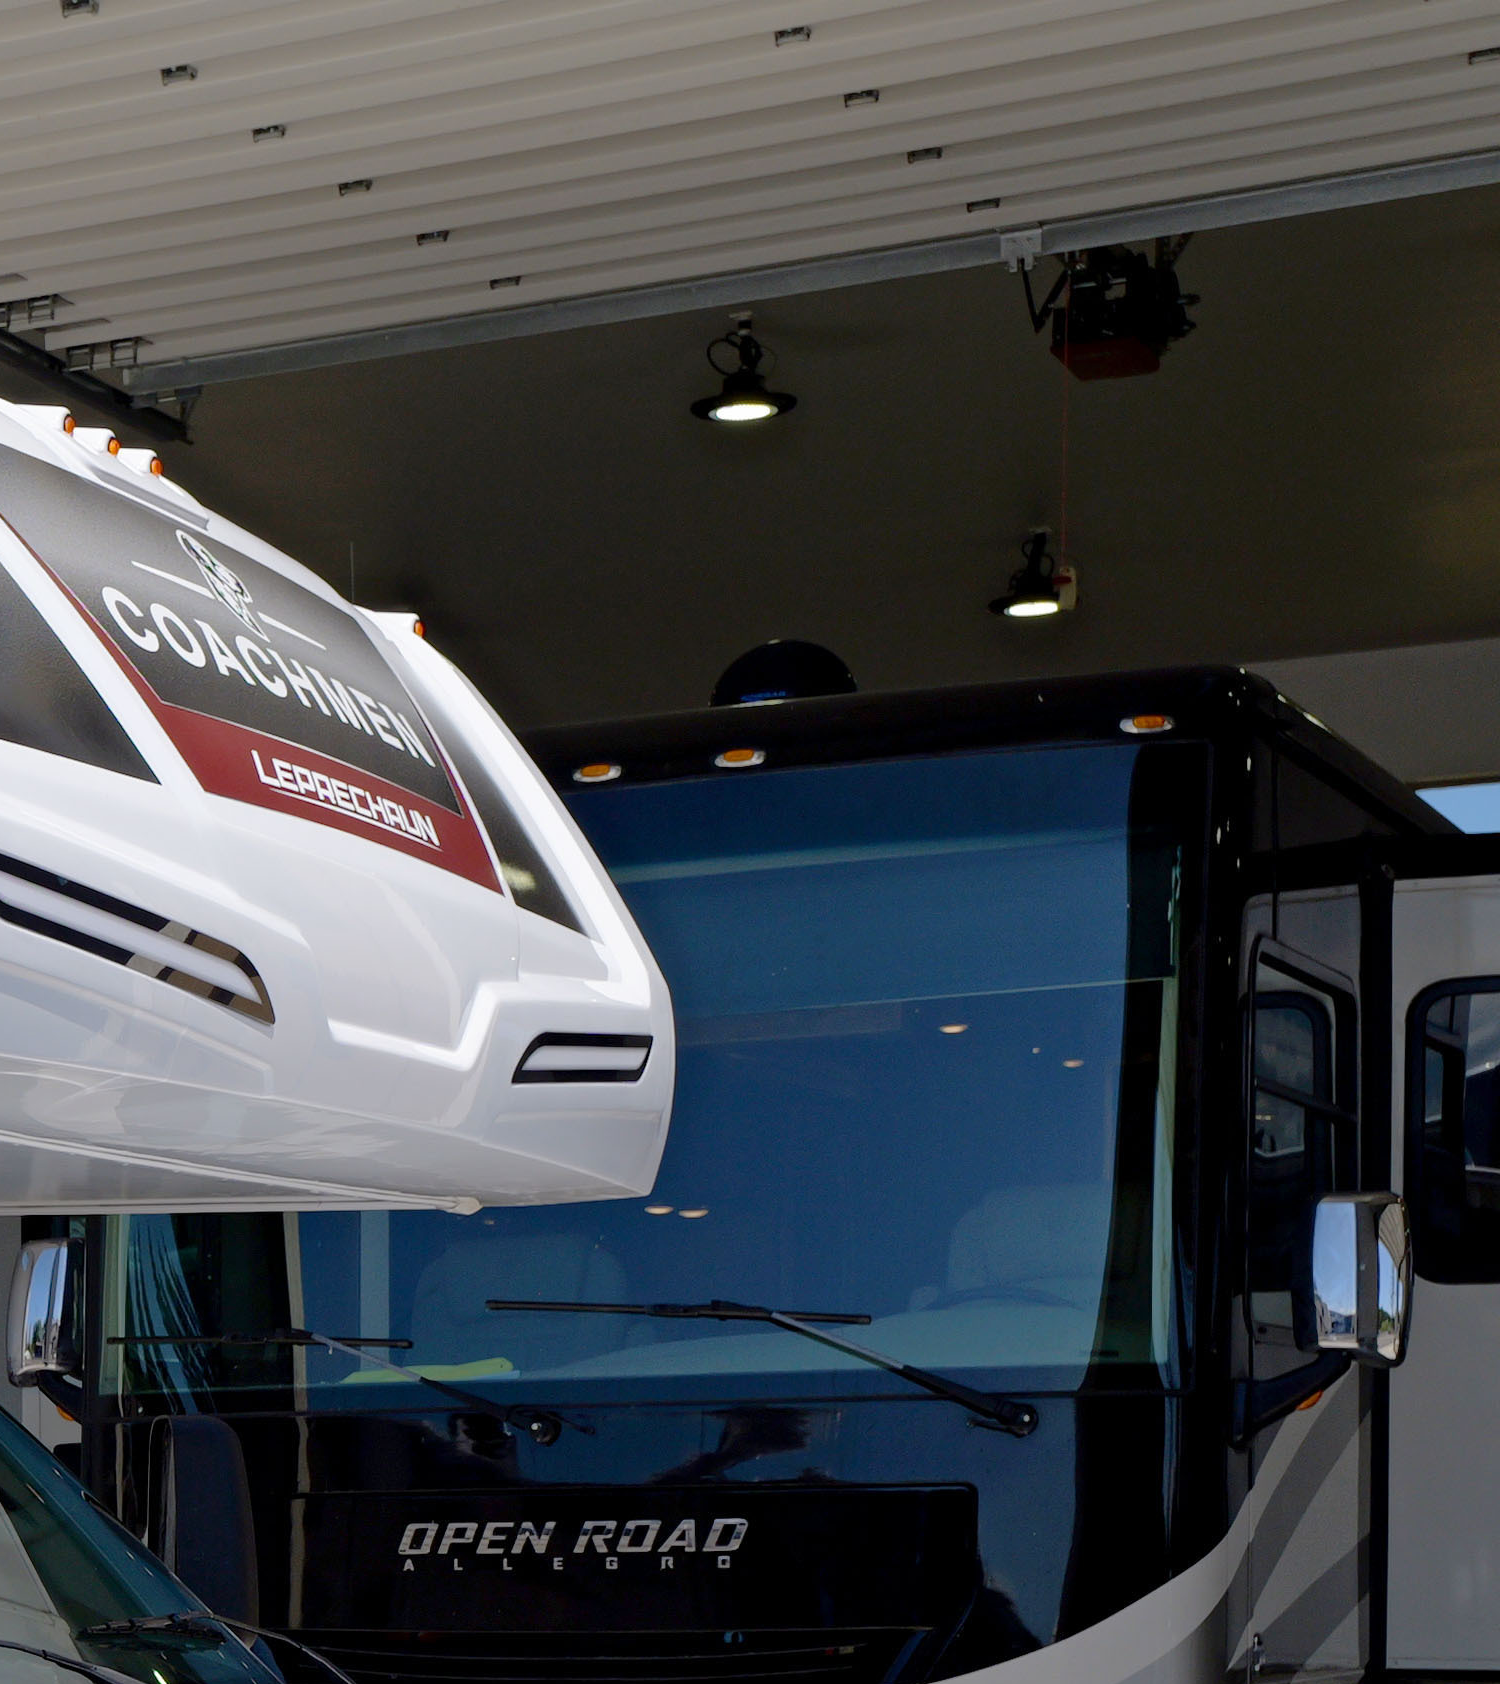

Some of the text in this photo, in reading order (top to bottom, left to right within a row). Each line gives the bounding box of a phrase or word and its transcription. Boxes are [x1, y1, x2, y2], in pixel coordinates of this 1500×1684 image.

[102, 586, 436, 768] COACHMEN
[251, 748, 441, 847] LEPRECHAUN
[398, 1518, 749, 1555] OPEN ROAD
[403, 1555, 731, 1571] ALLEGRO
